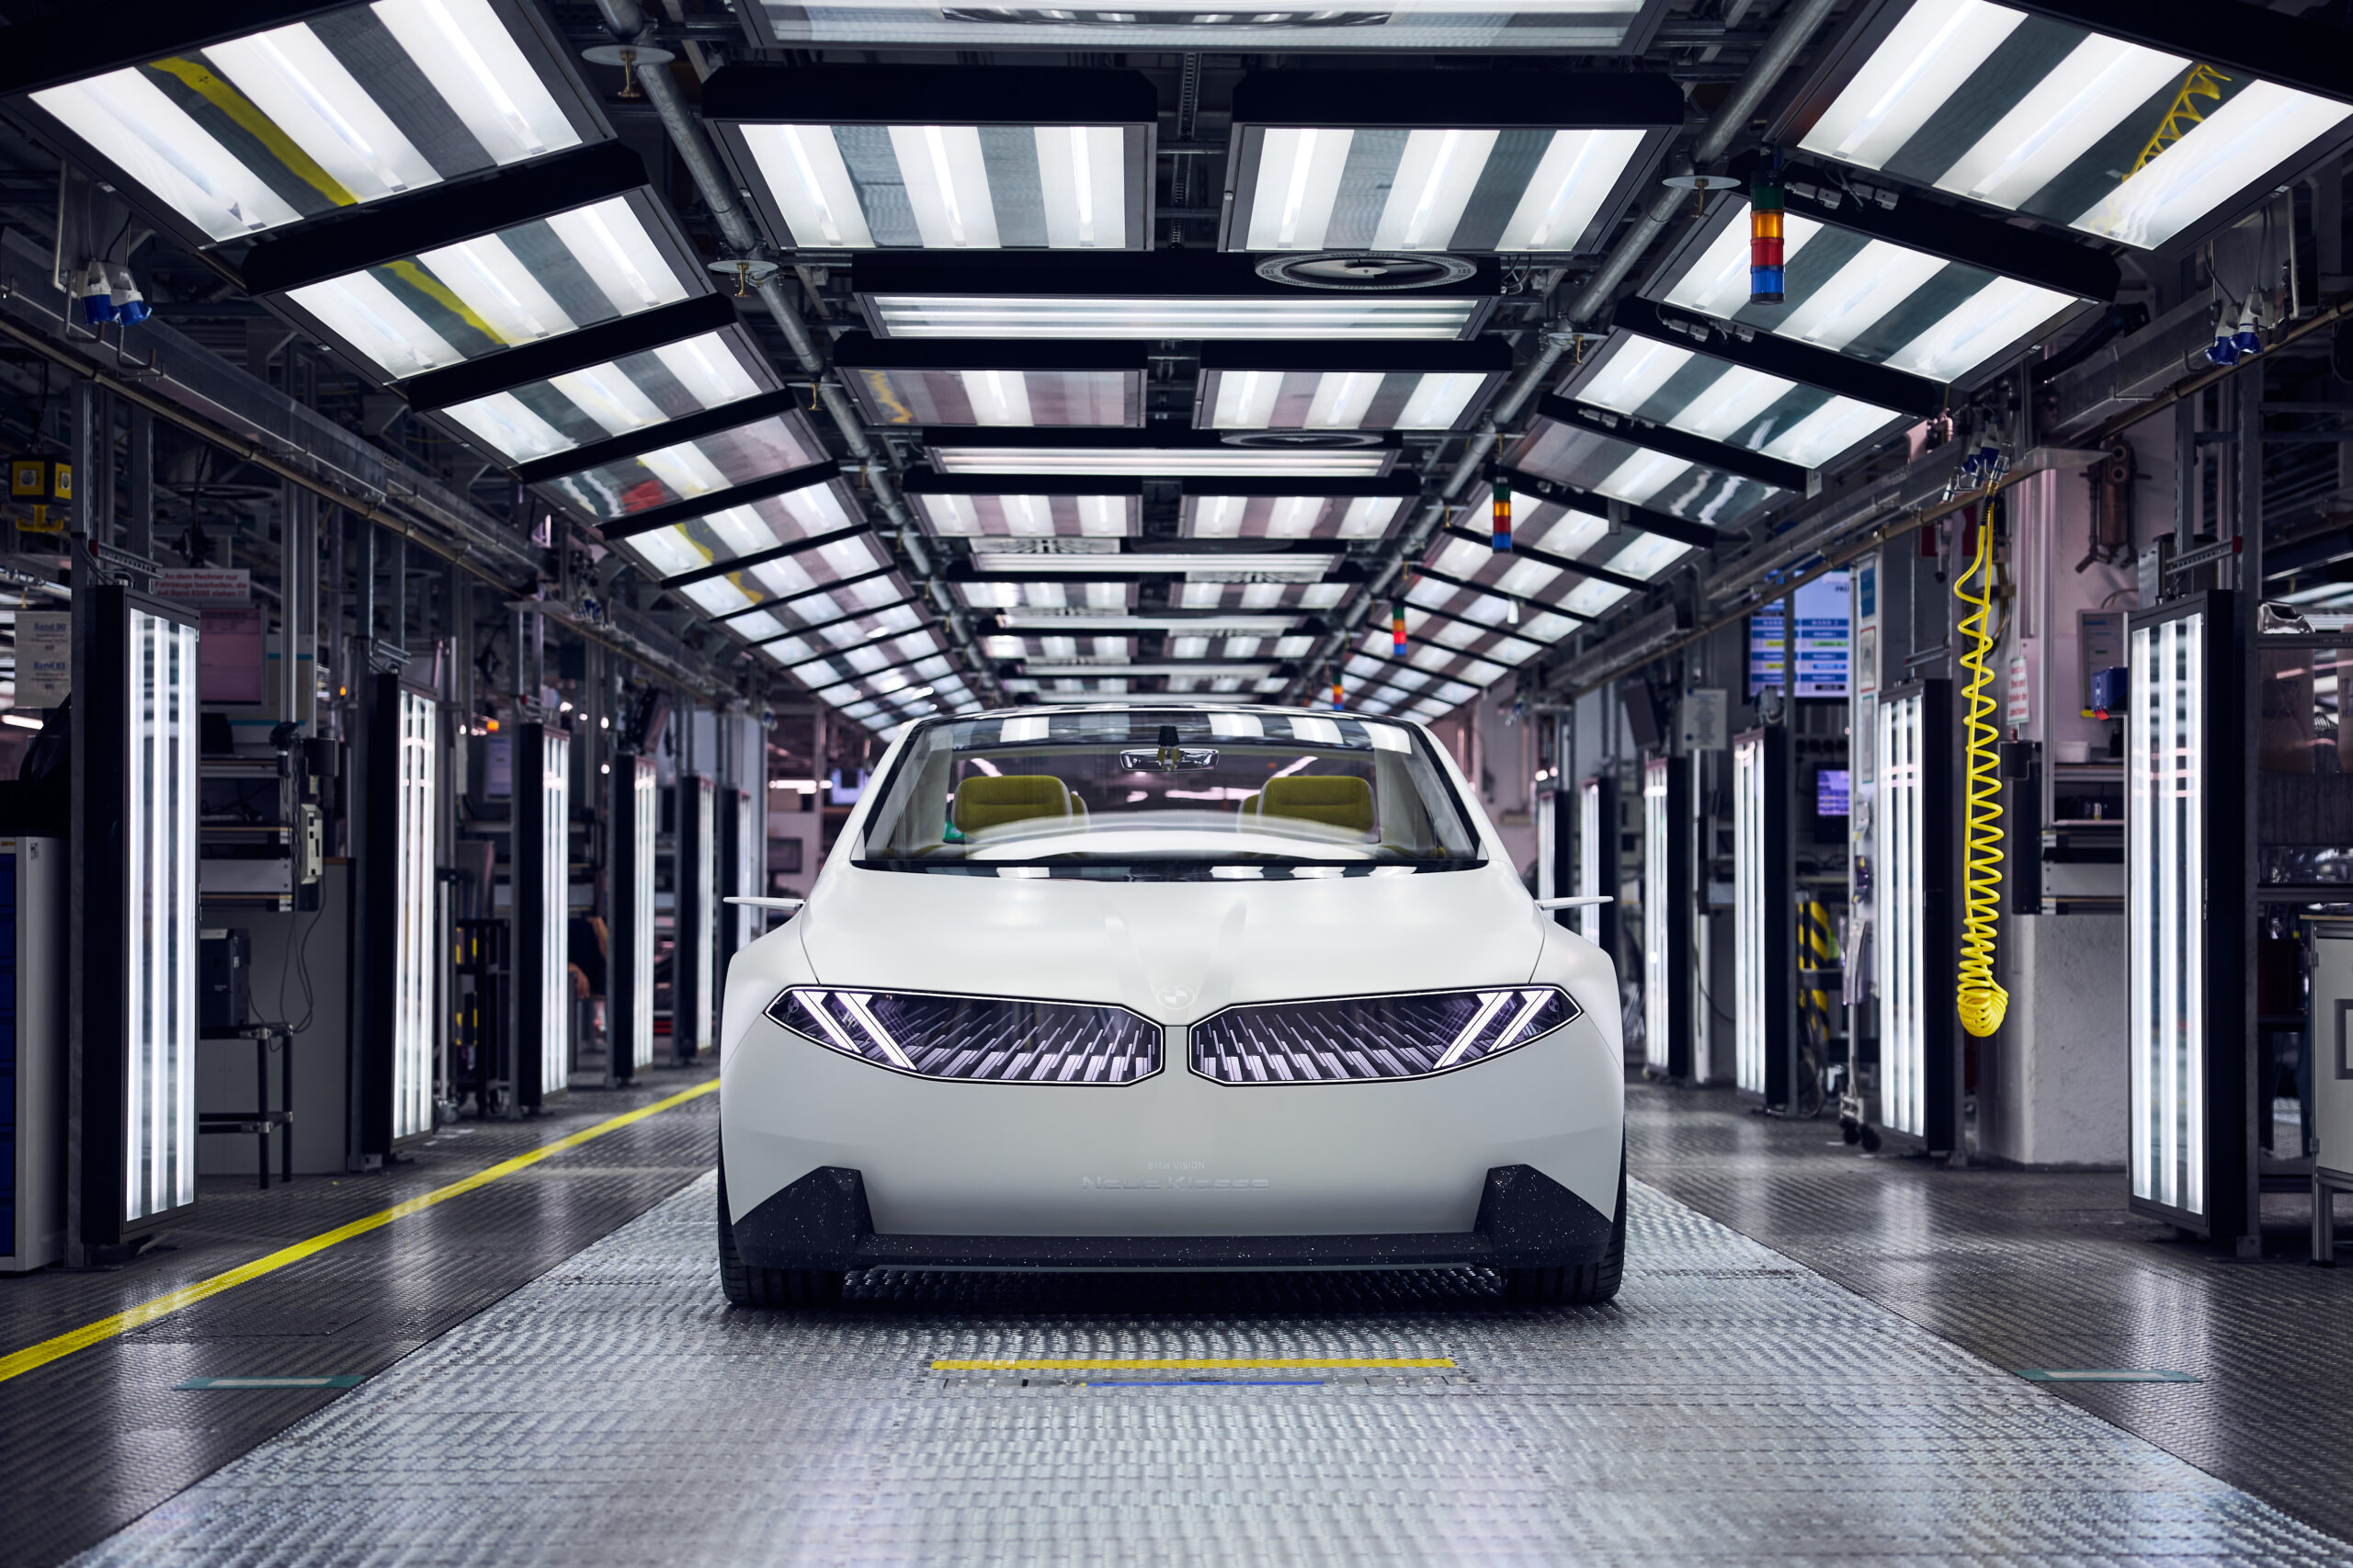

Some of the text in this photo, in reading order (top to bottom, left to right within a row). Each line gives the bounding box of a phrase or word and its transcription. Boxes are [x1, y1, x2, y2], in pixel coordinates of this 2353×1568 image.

[1147, 1161, 1205, 1170] BMW VISION
[1082, 1176, 1271, 1190] Neue Klasse
